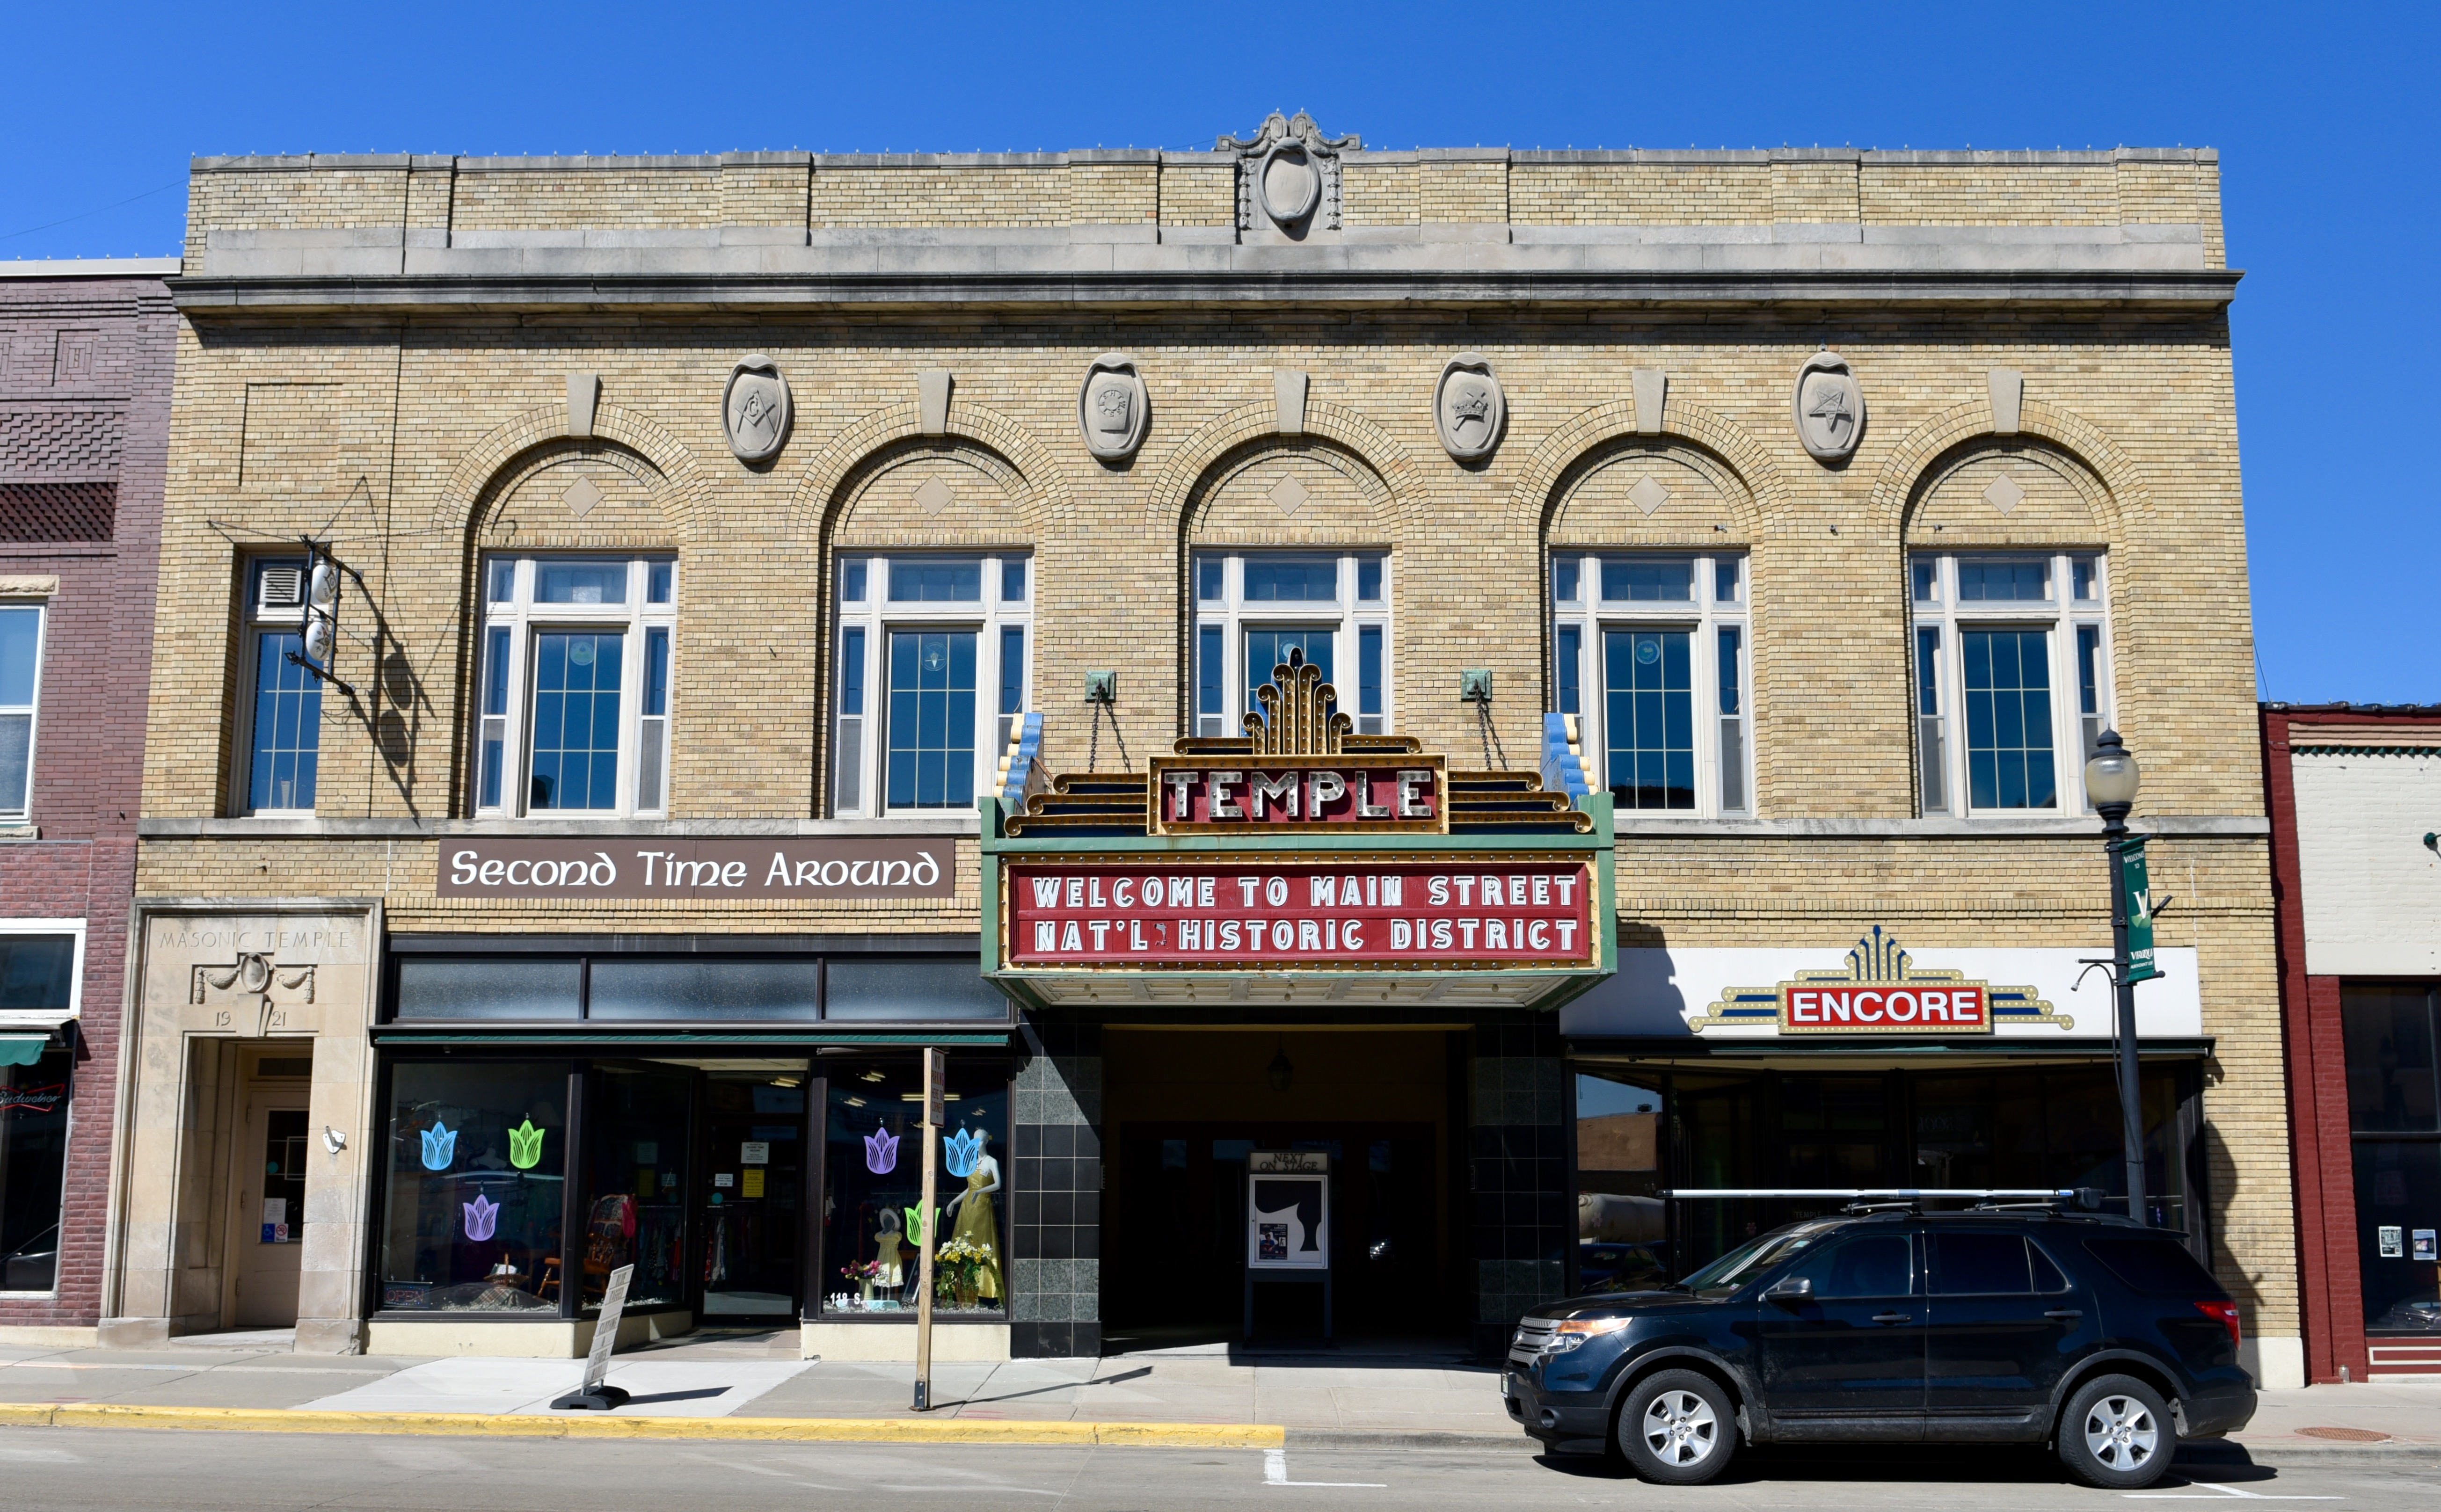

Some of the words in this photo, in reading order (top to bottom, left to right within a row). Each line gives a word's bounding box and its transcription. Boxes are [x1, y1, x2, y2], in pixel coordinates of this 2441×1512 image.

[1164, 770, 1431, 818] TEMPLE
[451, 850, 616, 887] Second
[636, 851, 747, 887] Time
[765, 850, 940, 887] Around
[1032, 876, 1216, 909] WELCOME
[1238, 876, 1288, 907] TO
[1310, 875, 1402, 907] MAIN
[1428, 874, 1577, 907] STREET
[159, 930, 251, 948] MASONIC
[264, 931, 350, 948] TEMPLE
[1034, 919, 1149, 952] NAT'L
[1178, 918, 1364, 952] HISTORIC
[1390, 917, 1578, 952] DISTRICT
[2130, 948, 2153, 960] VIROQU
[1792, 991, 1980, 1023] ENCORE
[215, 1011, 232, 1026] 19
[271, 1011, 287, 1026] 21
[1260, 1162, 1276, 1171] ON
[1283, 1162, 1318, 1171] STAGE
[1273, 1153, 1305, 1163] NEXT
[386, 1290, 425, 1303] OPEN
